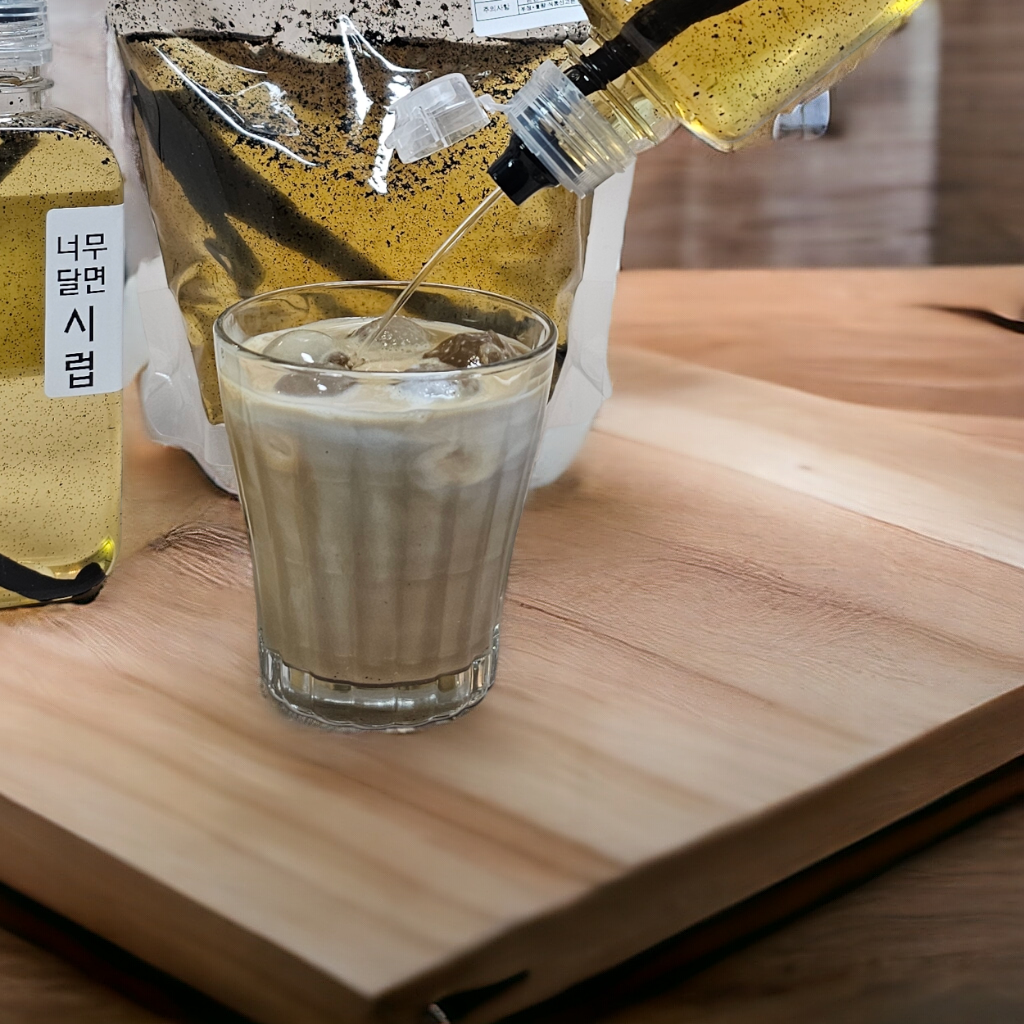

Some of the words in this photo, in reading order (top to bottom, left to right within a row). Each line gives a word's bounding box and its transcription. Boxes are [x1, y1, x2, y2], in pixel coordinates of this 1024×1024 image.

[57, 233, 108, 261] 너무
[57, 266, 106, 296] 달면
[64, 305, 94, 389] 시럽
